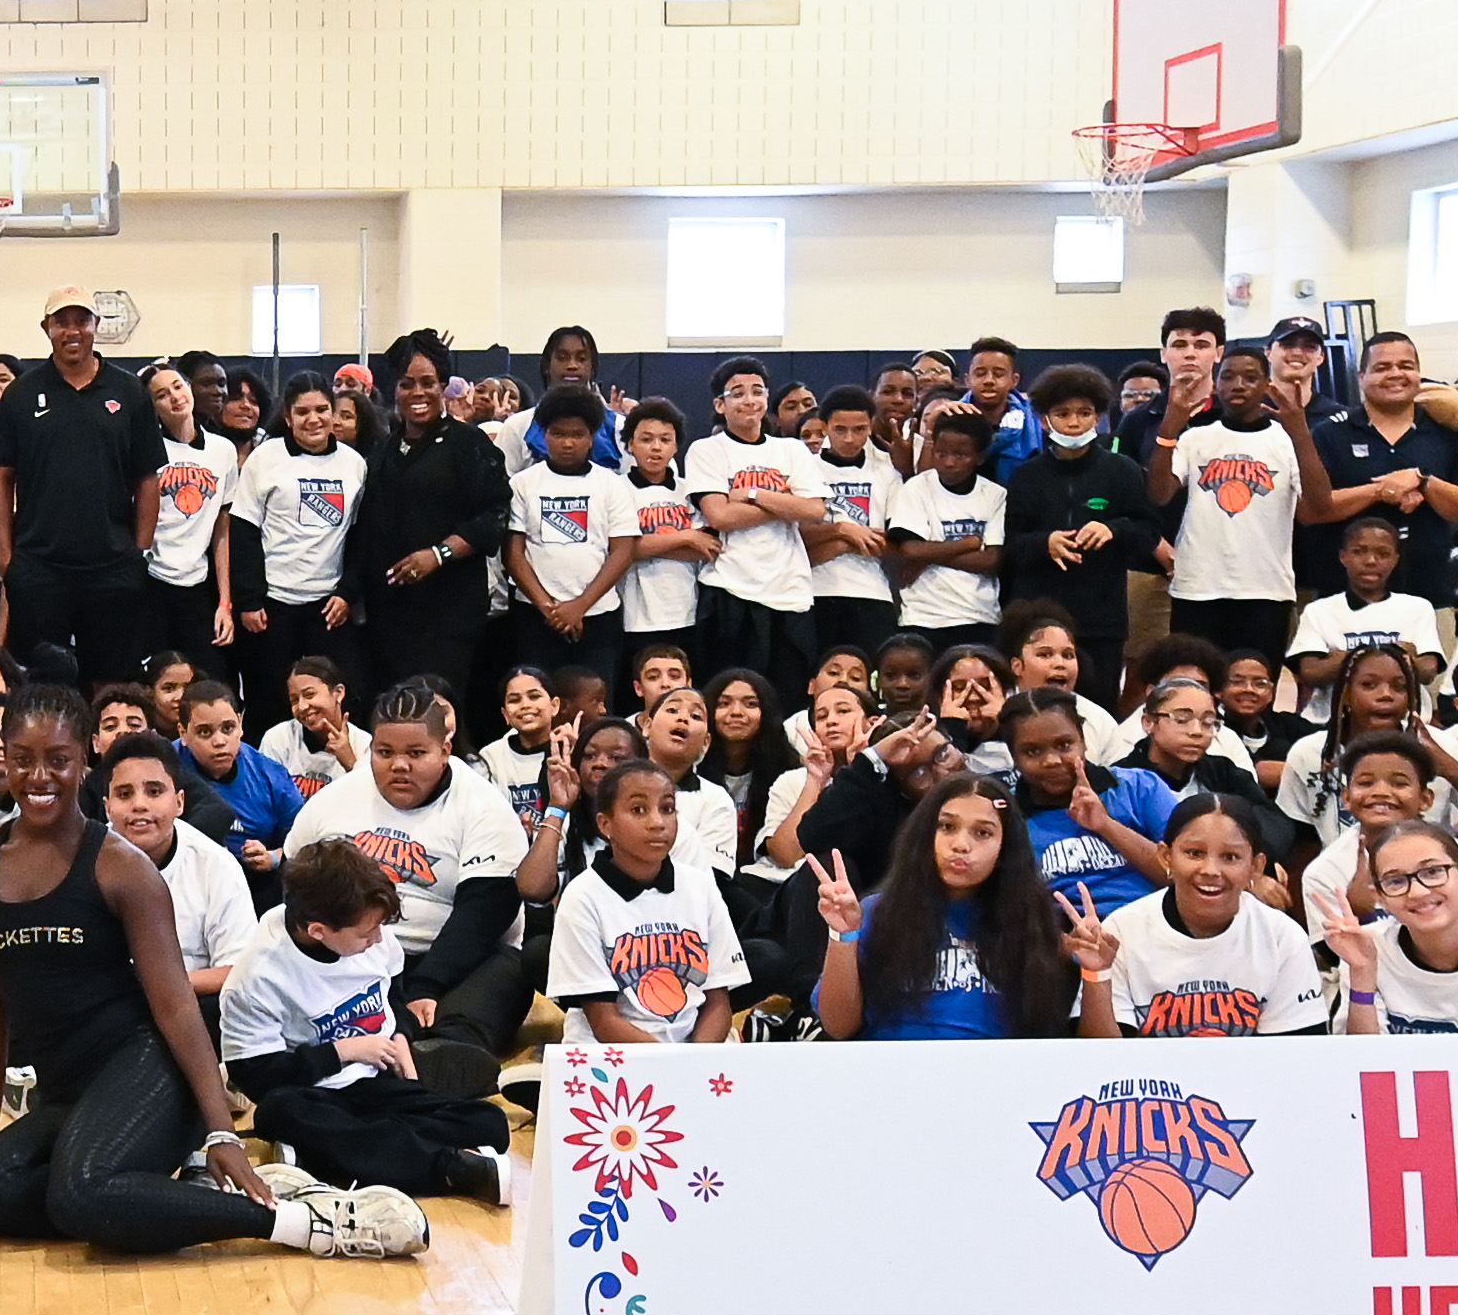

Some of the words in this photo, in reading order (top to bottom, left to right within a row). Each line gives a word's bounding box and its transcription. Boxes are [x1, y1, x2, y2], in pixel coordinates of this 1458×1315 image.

[1200, 458, 1276, 490] KNICKS
[307, 494, 342, 524] RANGERS
[543, 499, 561, 511] NEW
[563, 499, 587, 511] YORK
[635, 922, 654, 936] NEW
[655, 922, 679, 932] YORK
[611, 929, 709, 975] KNICKS
[1178, 981, 1200, 994] NEW
[1203, 980, 1231, 993] YORK
[320, 1010, 351, 1033] NEW
[1142, 988, 1260, 1033] KNICKS
[1098, 1078, 1133, 1101] NEW
[1138, 1078, 1183, 1100] YORK
[1037, 1094, 1254, 1180] KNICKS
